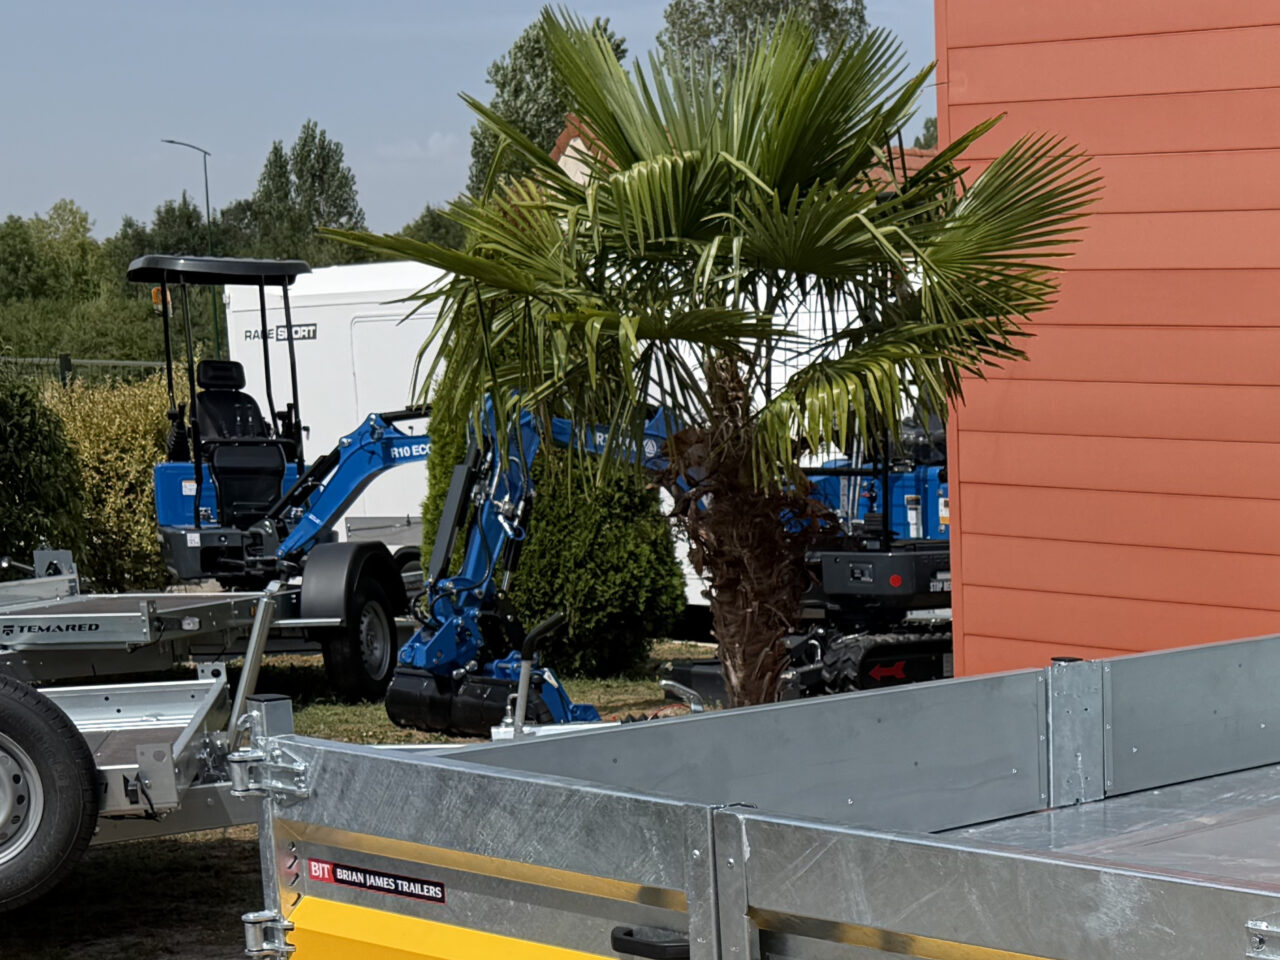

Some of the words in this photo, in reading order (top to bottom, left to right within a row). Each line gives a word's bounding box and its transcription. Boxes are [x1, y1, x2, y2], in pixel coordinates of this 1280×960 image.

[244, 328, 274, 340] RAE
[391, 446, 411, 459] R10
[17, 623, 100, 633] TEMARED
[336, 868, 364, 884] BRIAN
[366, 874, 395, 890] JAMES
[396, 880, 443, 899] TRAILERS
